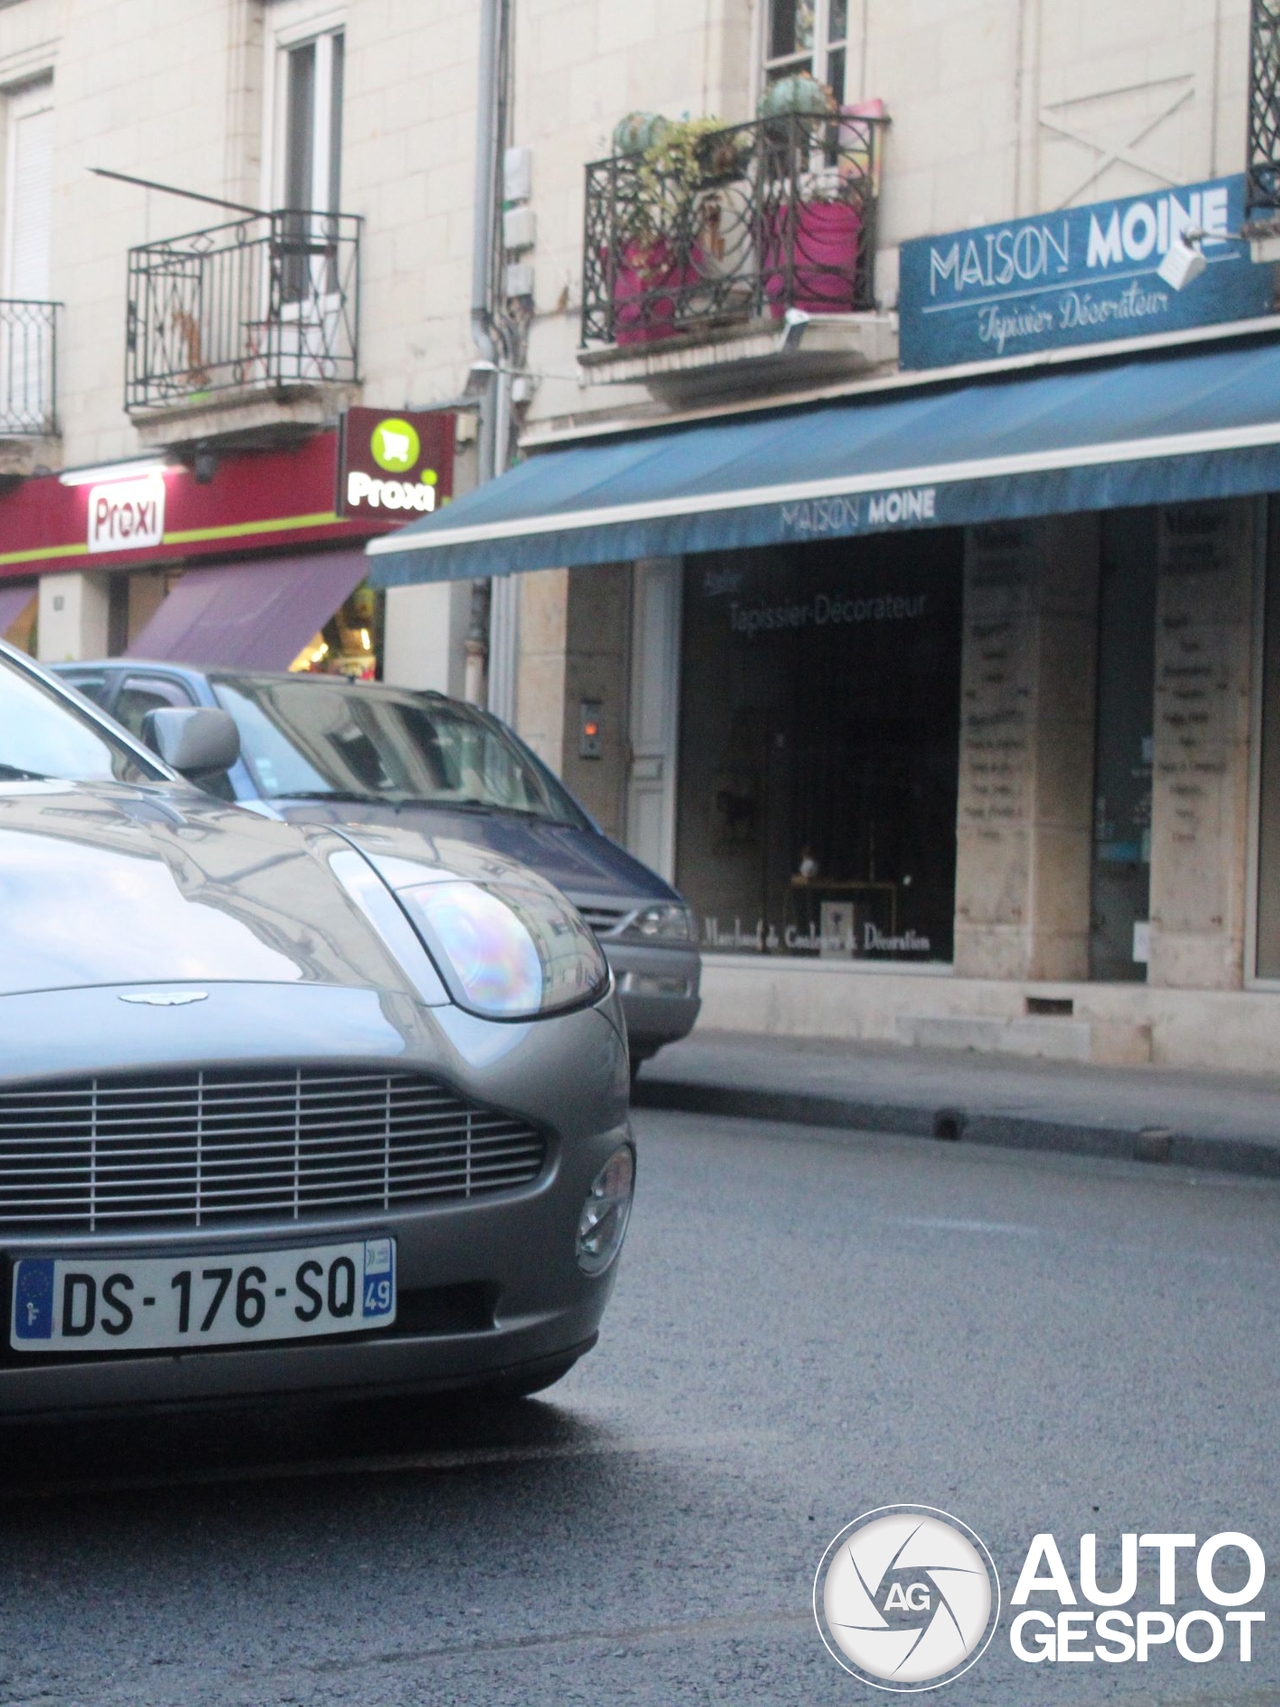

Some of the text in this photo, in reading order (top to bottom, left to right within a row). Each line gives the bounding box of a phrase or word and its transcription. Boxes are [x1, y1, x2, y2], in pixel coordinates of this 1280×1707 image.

[930, 186, 1228, 296] MAISON MOINE
[1060, 280, 1168, 330] Décorateur
[780, 487, 936, 534] MAISON MOINE
[62, 1256, 356, 1337] DS-176-SQ
[365, 1281, 390, 1311] 49
